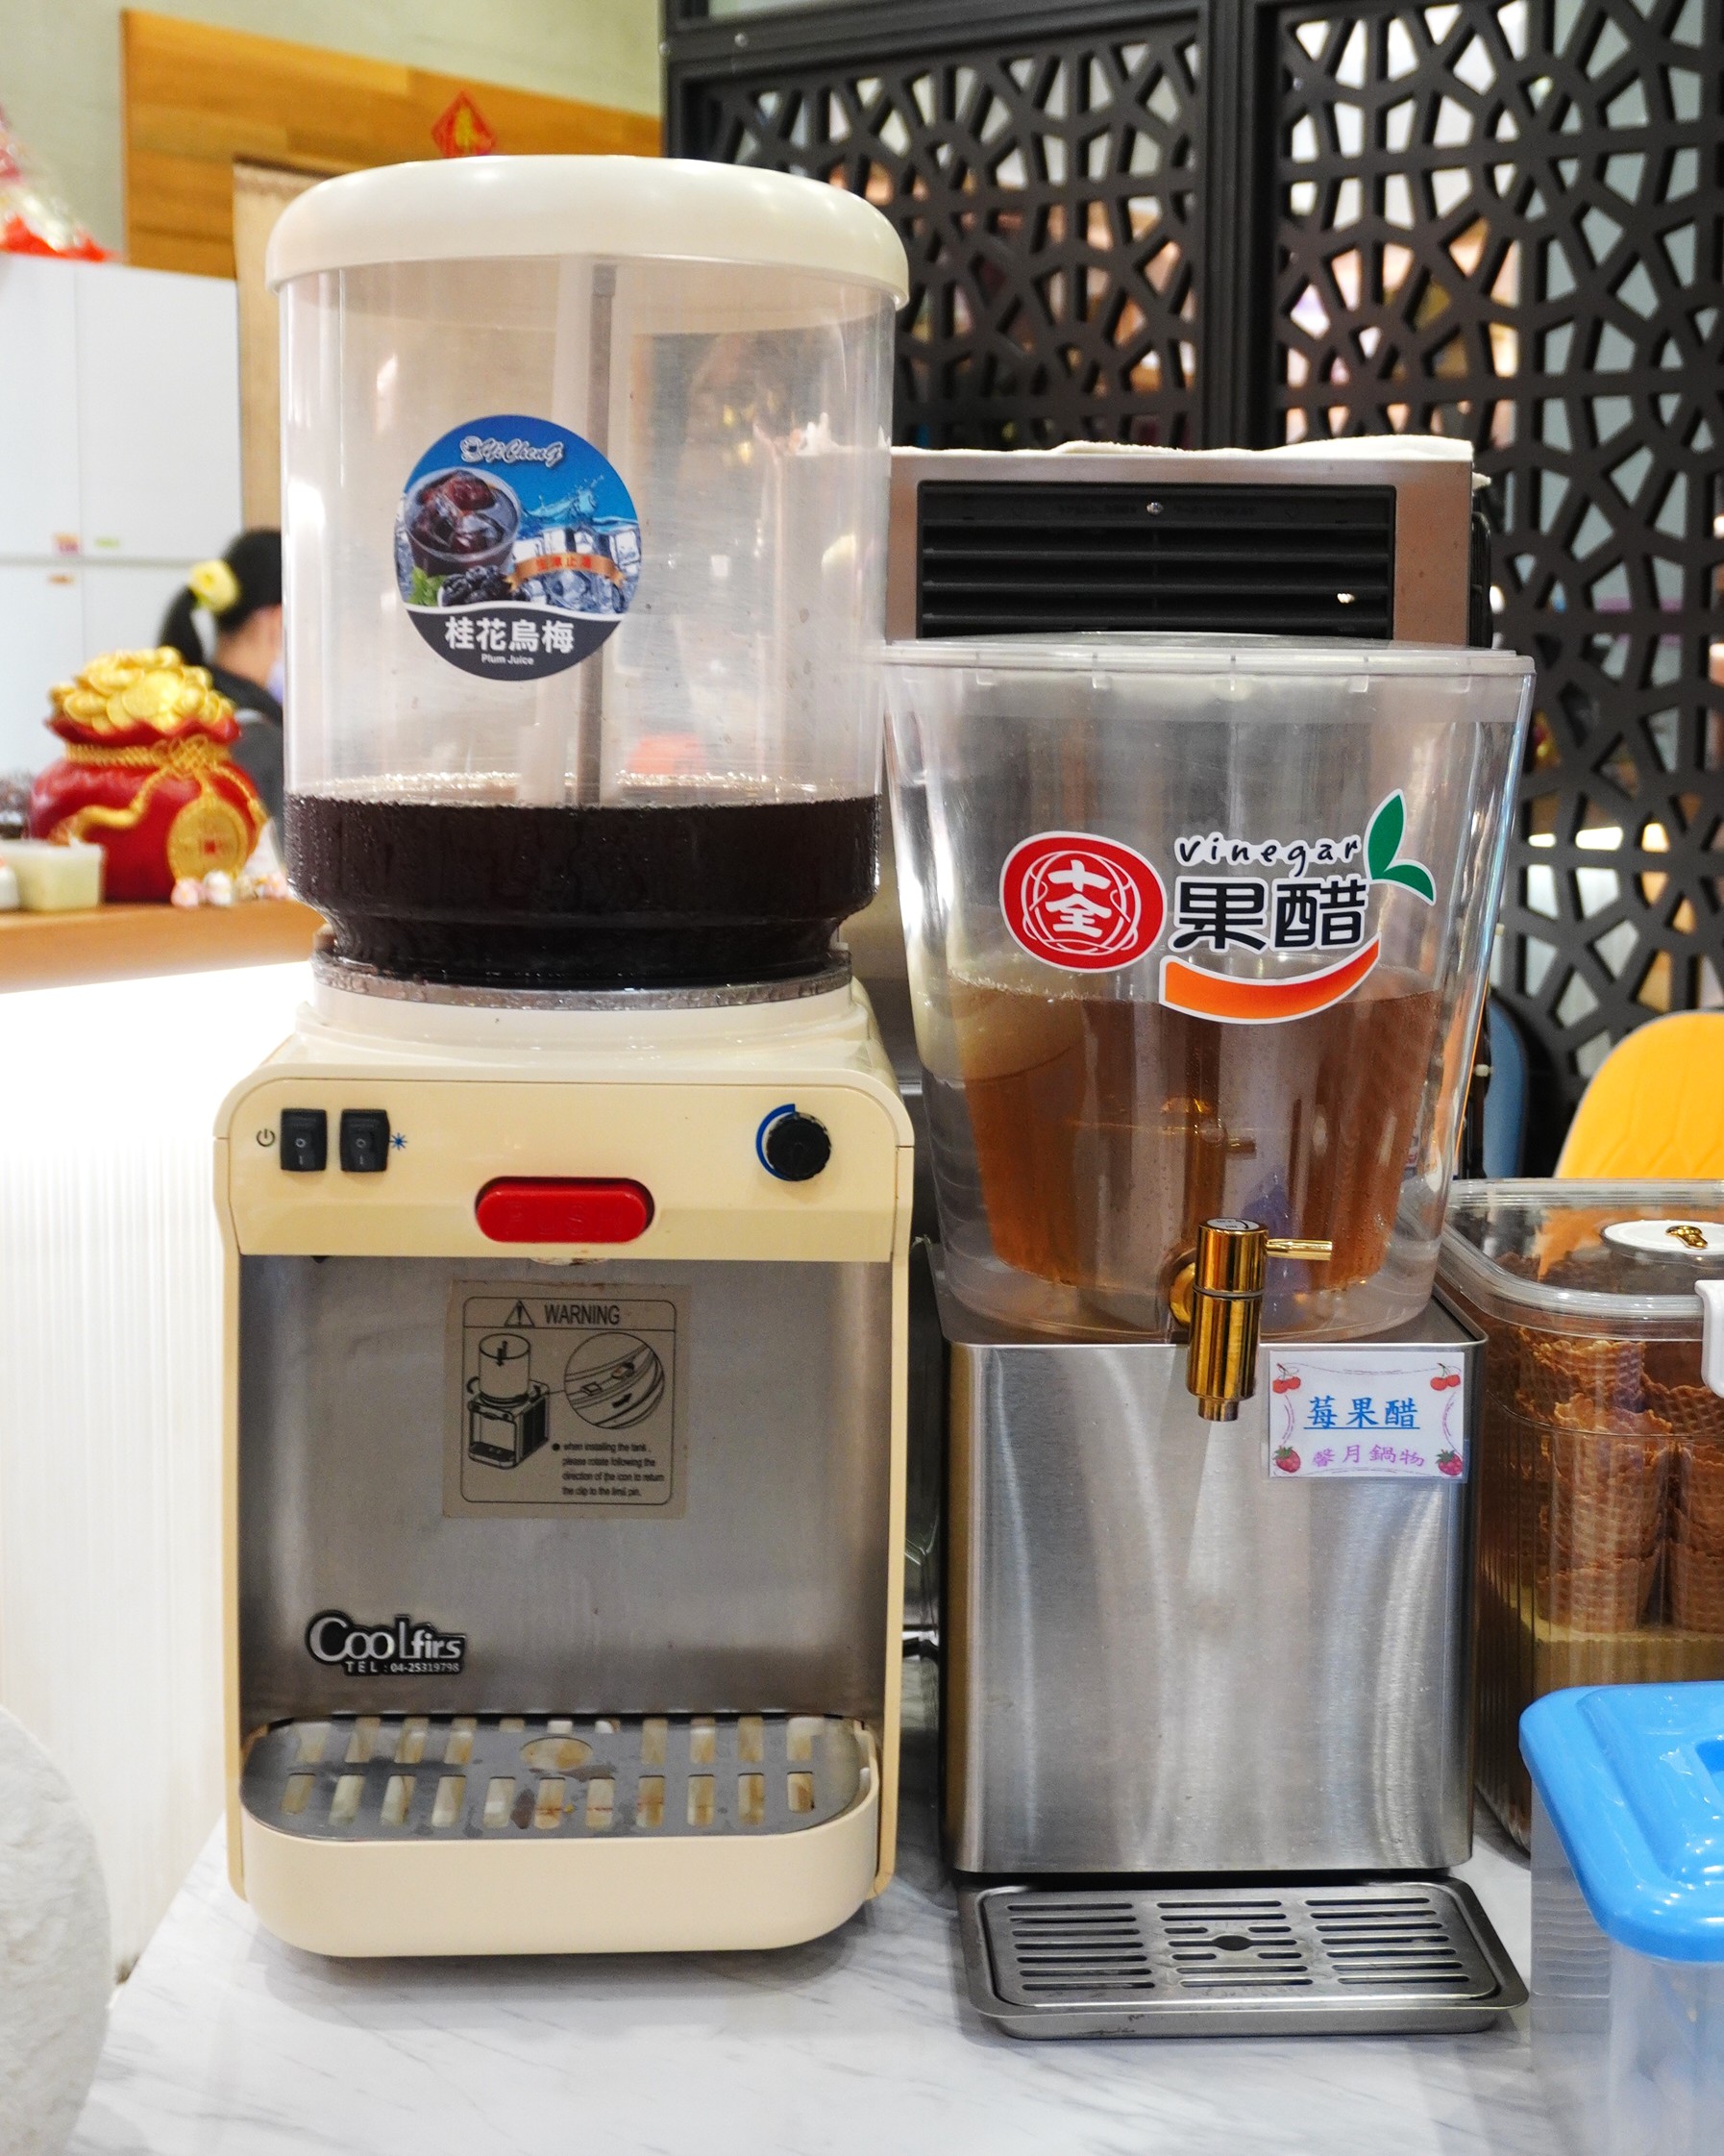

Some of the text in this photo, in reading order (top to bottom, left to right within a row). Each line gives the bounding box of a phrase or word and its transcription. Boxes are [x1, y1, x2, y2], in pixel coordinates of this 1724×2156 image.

[444, 616, 575, 654] 桂花烏梅
[481, 654, 534, 665] Plum Juice
[1170, 879, 1367, 951] 果醋
[544, 1304, 620, 1325] WARNING
[1306, 1395, 1418, 1428] 莓果醋
[1313, 1444, 1424, 1467] 馨月鍋物
